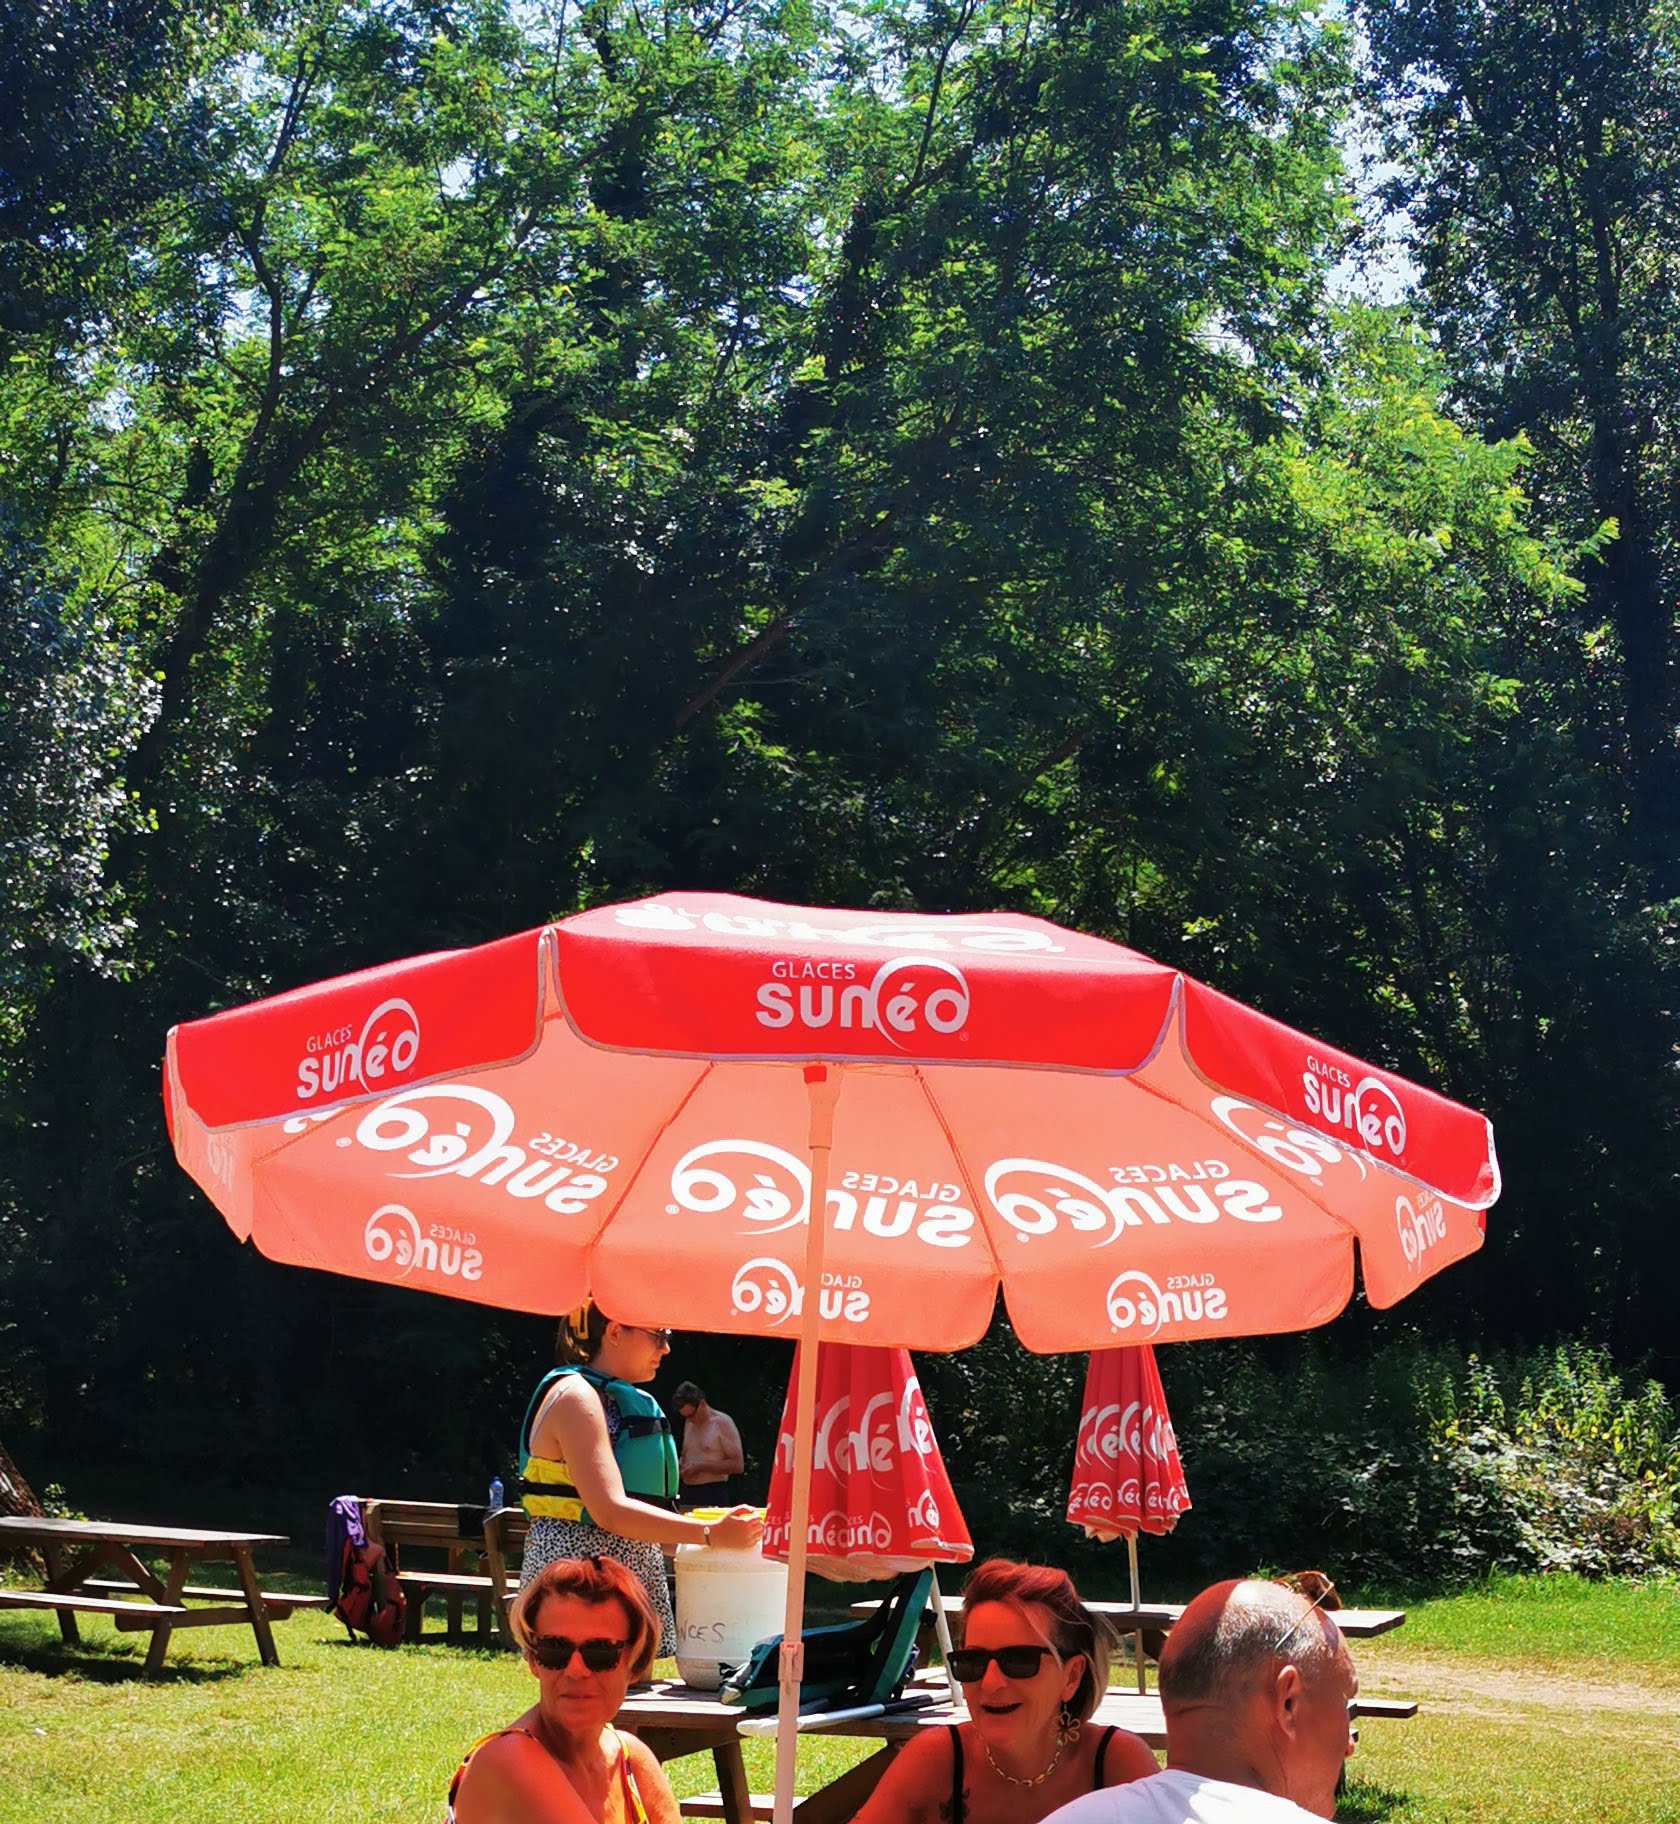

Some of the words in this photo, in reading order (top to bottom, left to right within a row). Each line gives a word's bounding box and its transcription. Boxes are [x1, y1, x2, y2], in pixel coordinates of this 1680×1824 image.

[772, 962, 856, 980] GLACES
[306, 1024, 352, 1053] GLACES
[1306, 1055, 1351, 1088] GLACES
